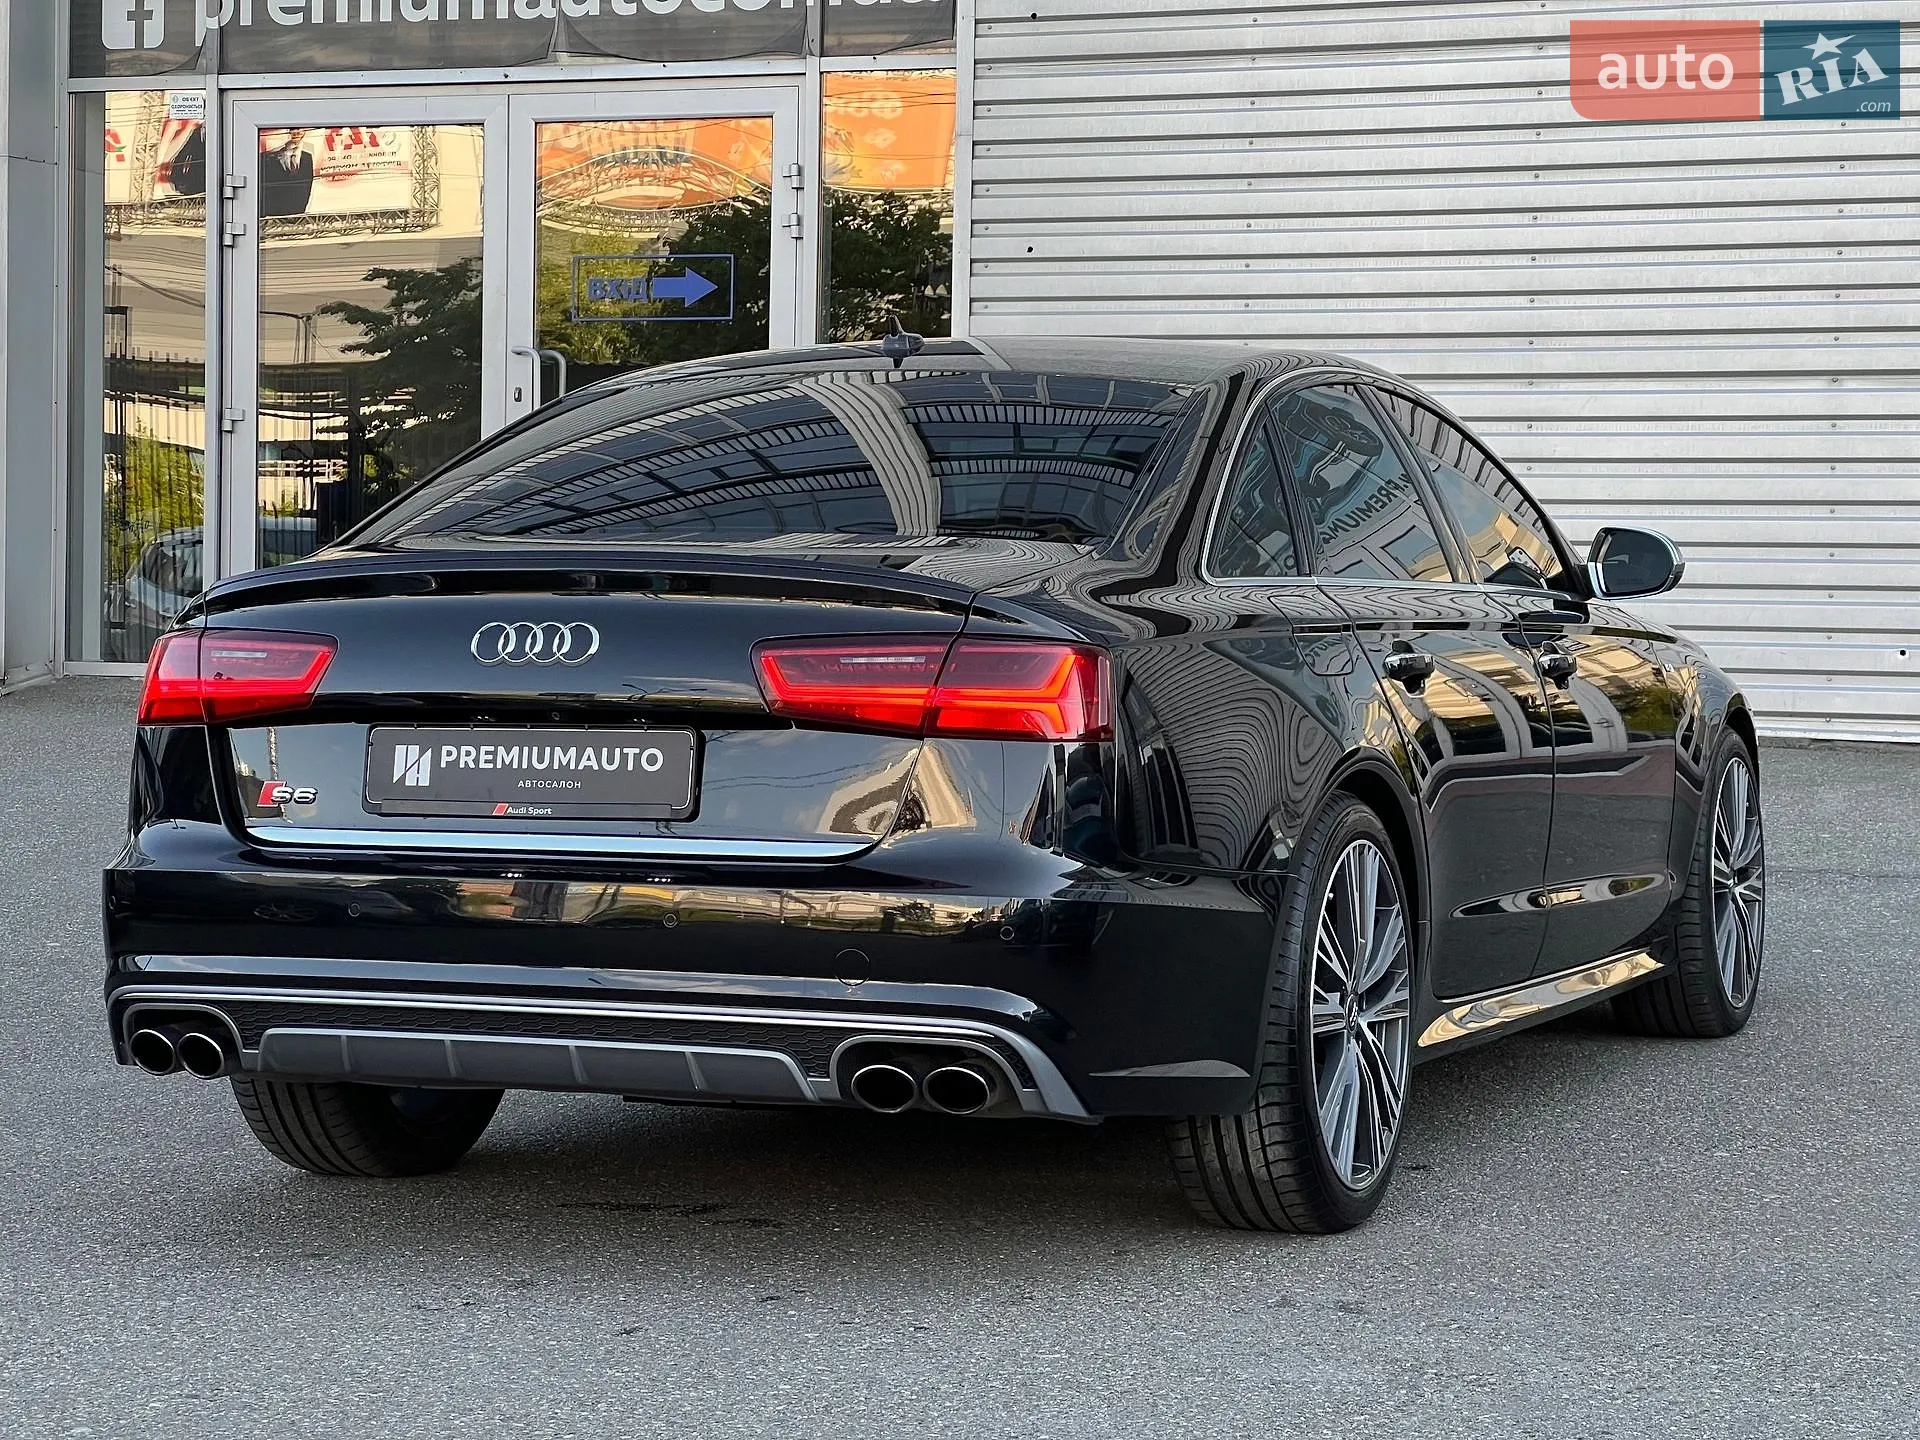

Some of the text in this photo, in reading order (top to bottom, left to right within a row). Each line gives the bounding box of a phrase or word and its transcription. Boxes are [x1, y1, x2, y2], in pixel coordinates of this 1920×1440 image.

[439, 745, 665, 772] PREMIUMAUTO
[517, 779, 582, 790] АВТОСАЛОН
[270, 786, 319, 805] S6
[506, 805, 552, 816] Audi Sport
